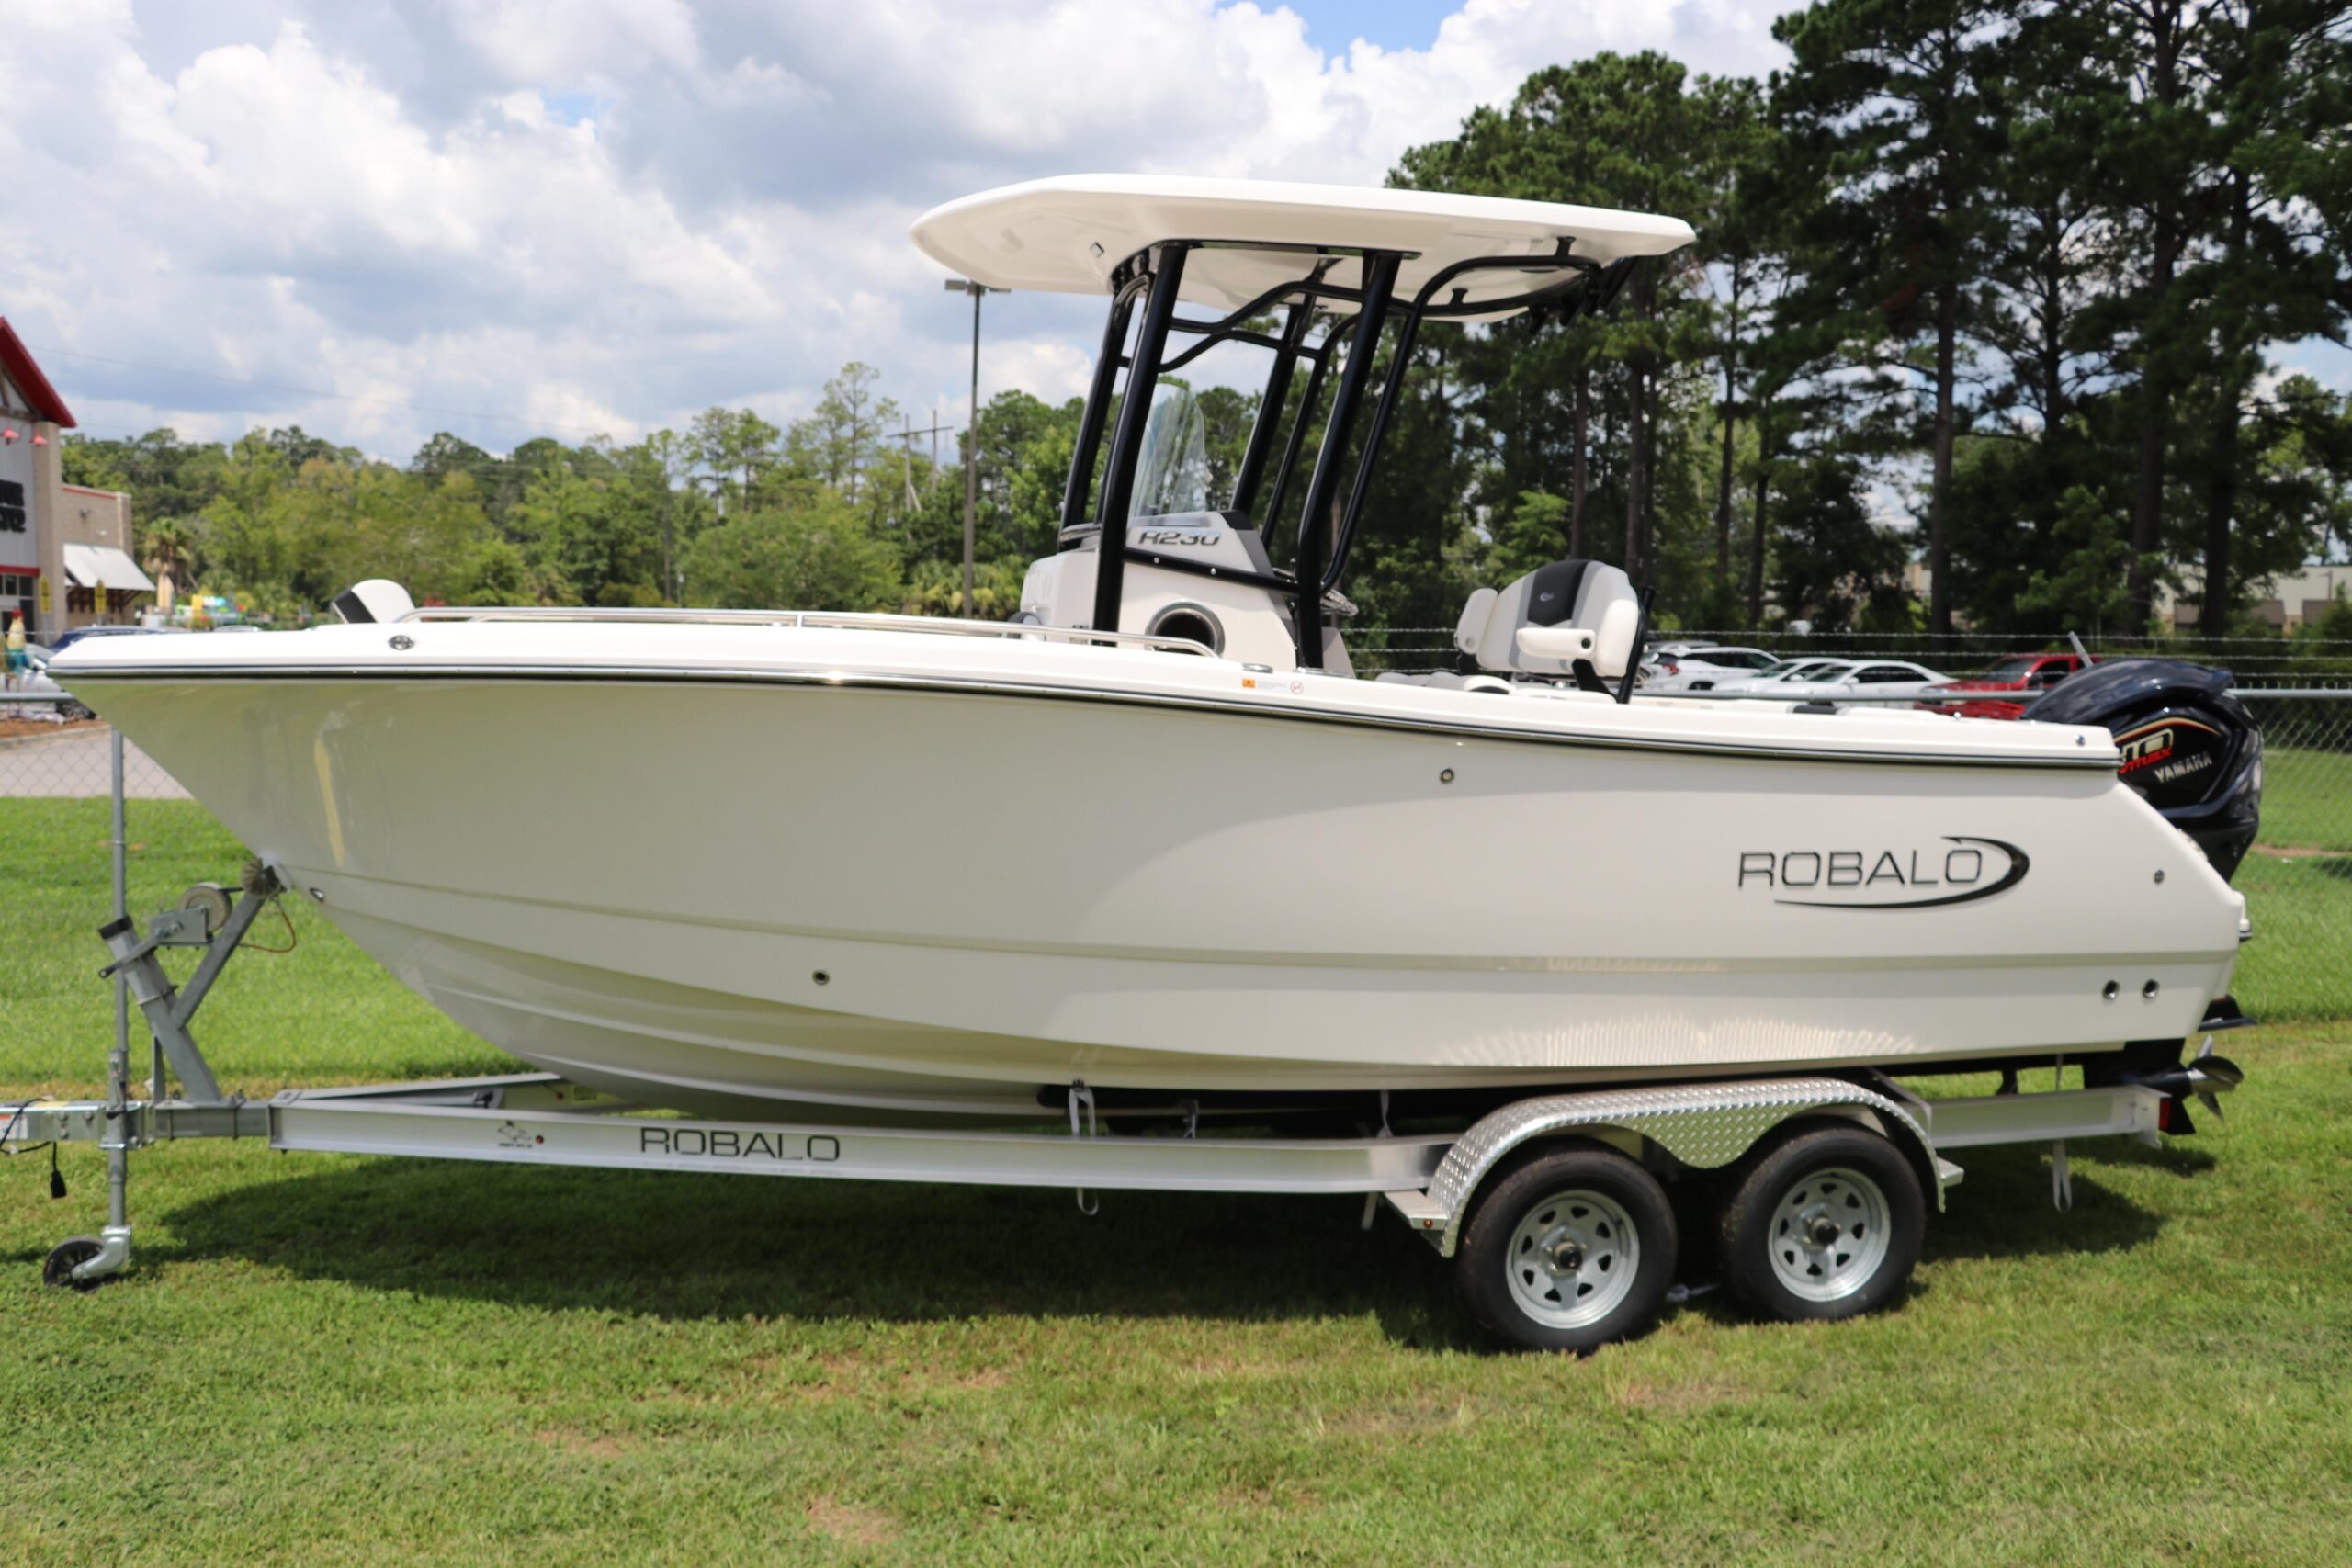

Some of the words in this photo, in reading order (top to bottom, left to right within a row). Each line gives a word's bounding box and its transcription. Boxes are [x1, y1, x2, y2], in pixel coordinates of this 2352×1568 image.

[1138, 529, 1221, 546] R230
[2154, 751, 2213, 784] YAMAHA
[1738, 849, 1984, 887] ROBALO
[640, 1127, 841, 1162] ROBALO
